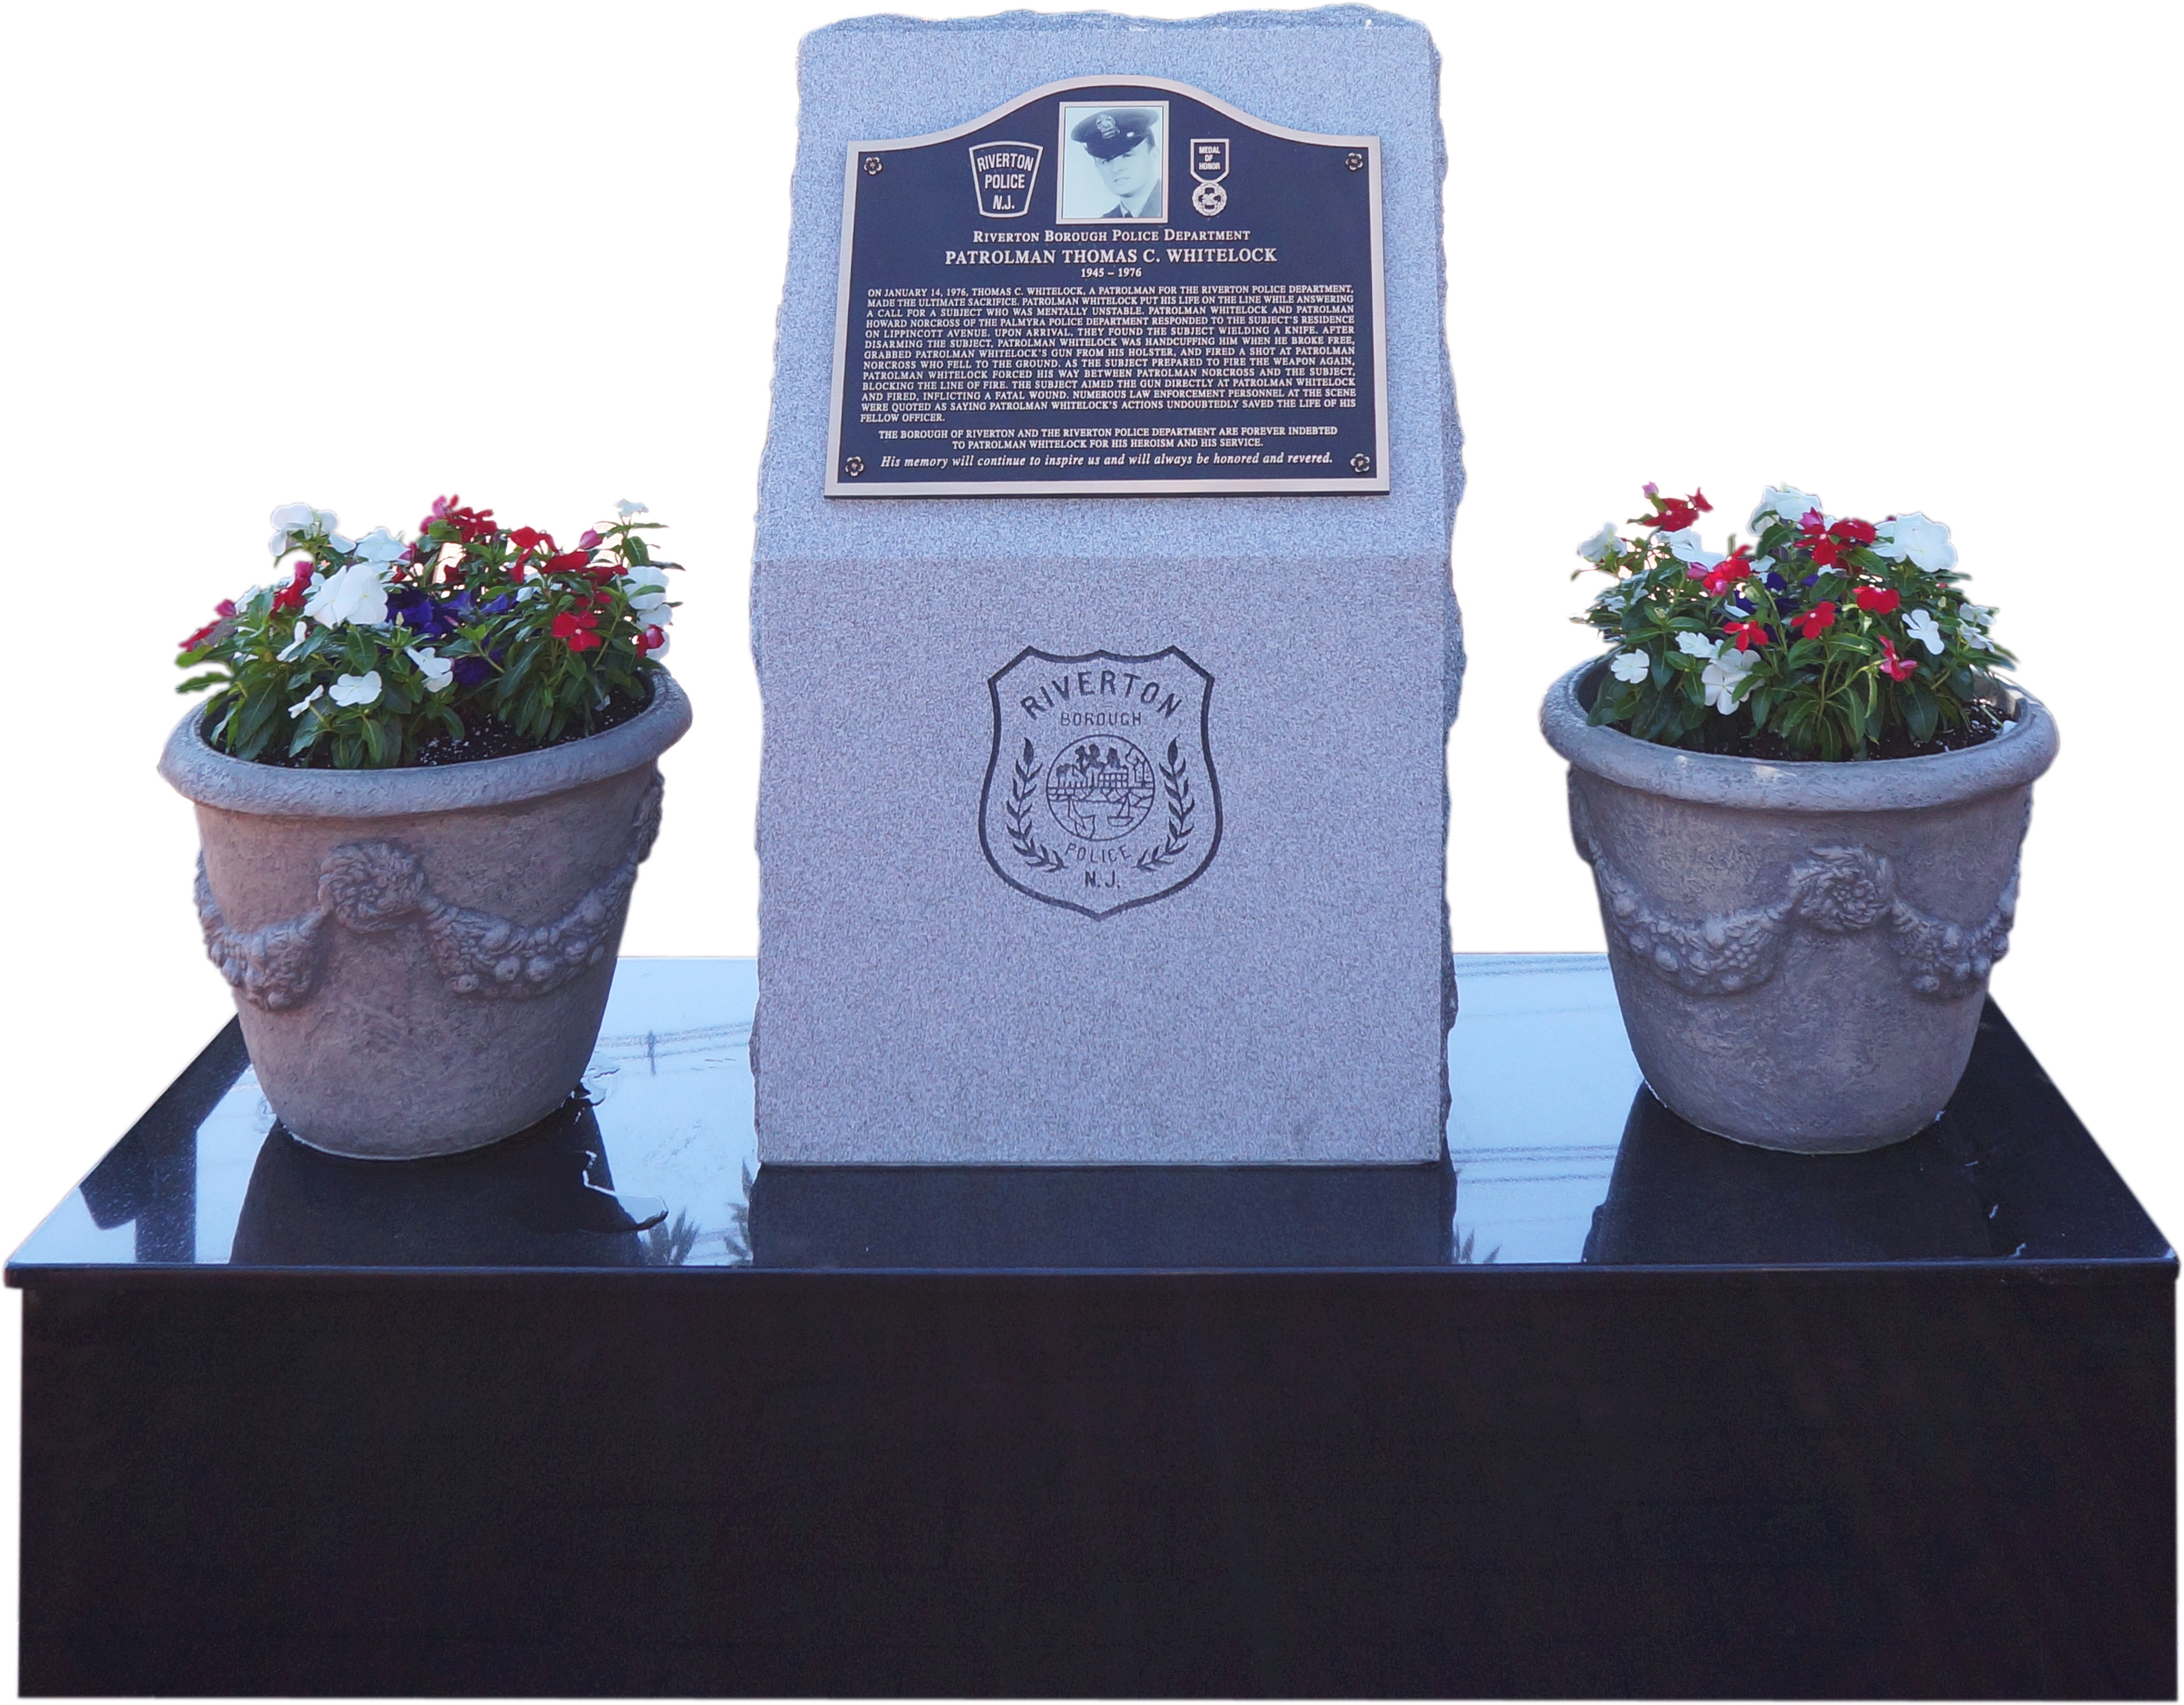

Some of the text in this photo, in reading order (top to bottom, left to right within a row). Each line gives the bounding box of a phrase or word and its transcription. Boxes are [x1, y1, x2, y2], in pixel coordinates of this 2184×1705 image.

[977, 153, 1035, 172] RIVERTON
[984, 174, 1025, 189] POLICE
[993, 195, 1015, 210] N.J.
[946, 248, 1276, 264] PATROLMAN THOMAS C. WHITELOCK
[1081, 267, 1104, 277] 1945
[1118, 267, 1141, 276] 1976
[868, 288, 882, 297] ON
[884, 287, 927, 297] JANUARY
[931, 287, 943, 298] 14,
[971, 286, 1011, 296] THOMAS
[1014, 286, 1023, 296] C.
[1088, 286, 1096, 295] A
[1098, 286, 1155, 295] PATROLMAN
[1158, 286, 1176, 295] FOR
[1179, 285, 1199, 294] THE
[1201, 285, 1249, 294] RIVERTON
[1251, 285, 1286, 294] POLICE
[1289, 284, 1353, 294] DEPARTMENT,
[867, 294, 1353, 307] MADE THE ULTIMATE SACRIFICE. PATROLMAN WHITELOCK PUT HIS LIFE ON THE LINE WHILE ANSWERING
[866, 314, 1354, 328] HOWARD NORCROSS OF THE PALMYRA POLICE DEPARTMENT RESPONDED TO THE SUBJECT'S RESIDENCE
[864, 335, 1354, 349] DISARMING THE SUBJECT, PATROLMAN WHITELOCK WAS HANDCUFFING HIM WHEN HE BROKE FREE,
[863, 366, 1355, 380] PATROLMAN WHITELOCK FORCED HIS WAY BETWEEN PATROLMAN NORCROSS AND THE SUBJECT,
[862, 376, 1355, 390] BLOCKING THE LINE OF FIRE. THE SUBJECT AIMED THE GUN DIRECTLY AT PATROLMAN WHITELOCK
[861, 398, 1355, 412] WERE QUOTED AS SAYING PATROLMAN WHITELOCK'S ACTIONS UNDOUBTEDLY SAVED THE LIFE OF HIS
[860, 413, 945, 422] FELLOW OFFICER.
[878, 426, 1338, 439] THE BOROUGH OF RIVERTON AND THE RIVERTON POLICE DEPARTMENT ARE FOREVER INDEBTED
[951, 438, 1263, 449] TO PATROLMAN WHITELOCK FOR HIS HEROISM AND HIS SERVICE.
[881, 452, 1332, 468] His memory will continue to inspire us and will always be honored and revered.
[1021, 670, 1182, 720] RIVERTON
[1060, 712, 1141, 726] BOROUGH
[1065, 842, 1132, 863] POLICE
[1085, 871, 1121, 888] N.J.
